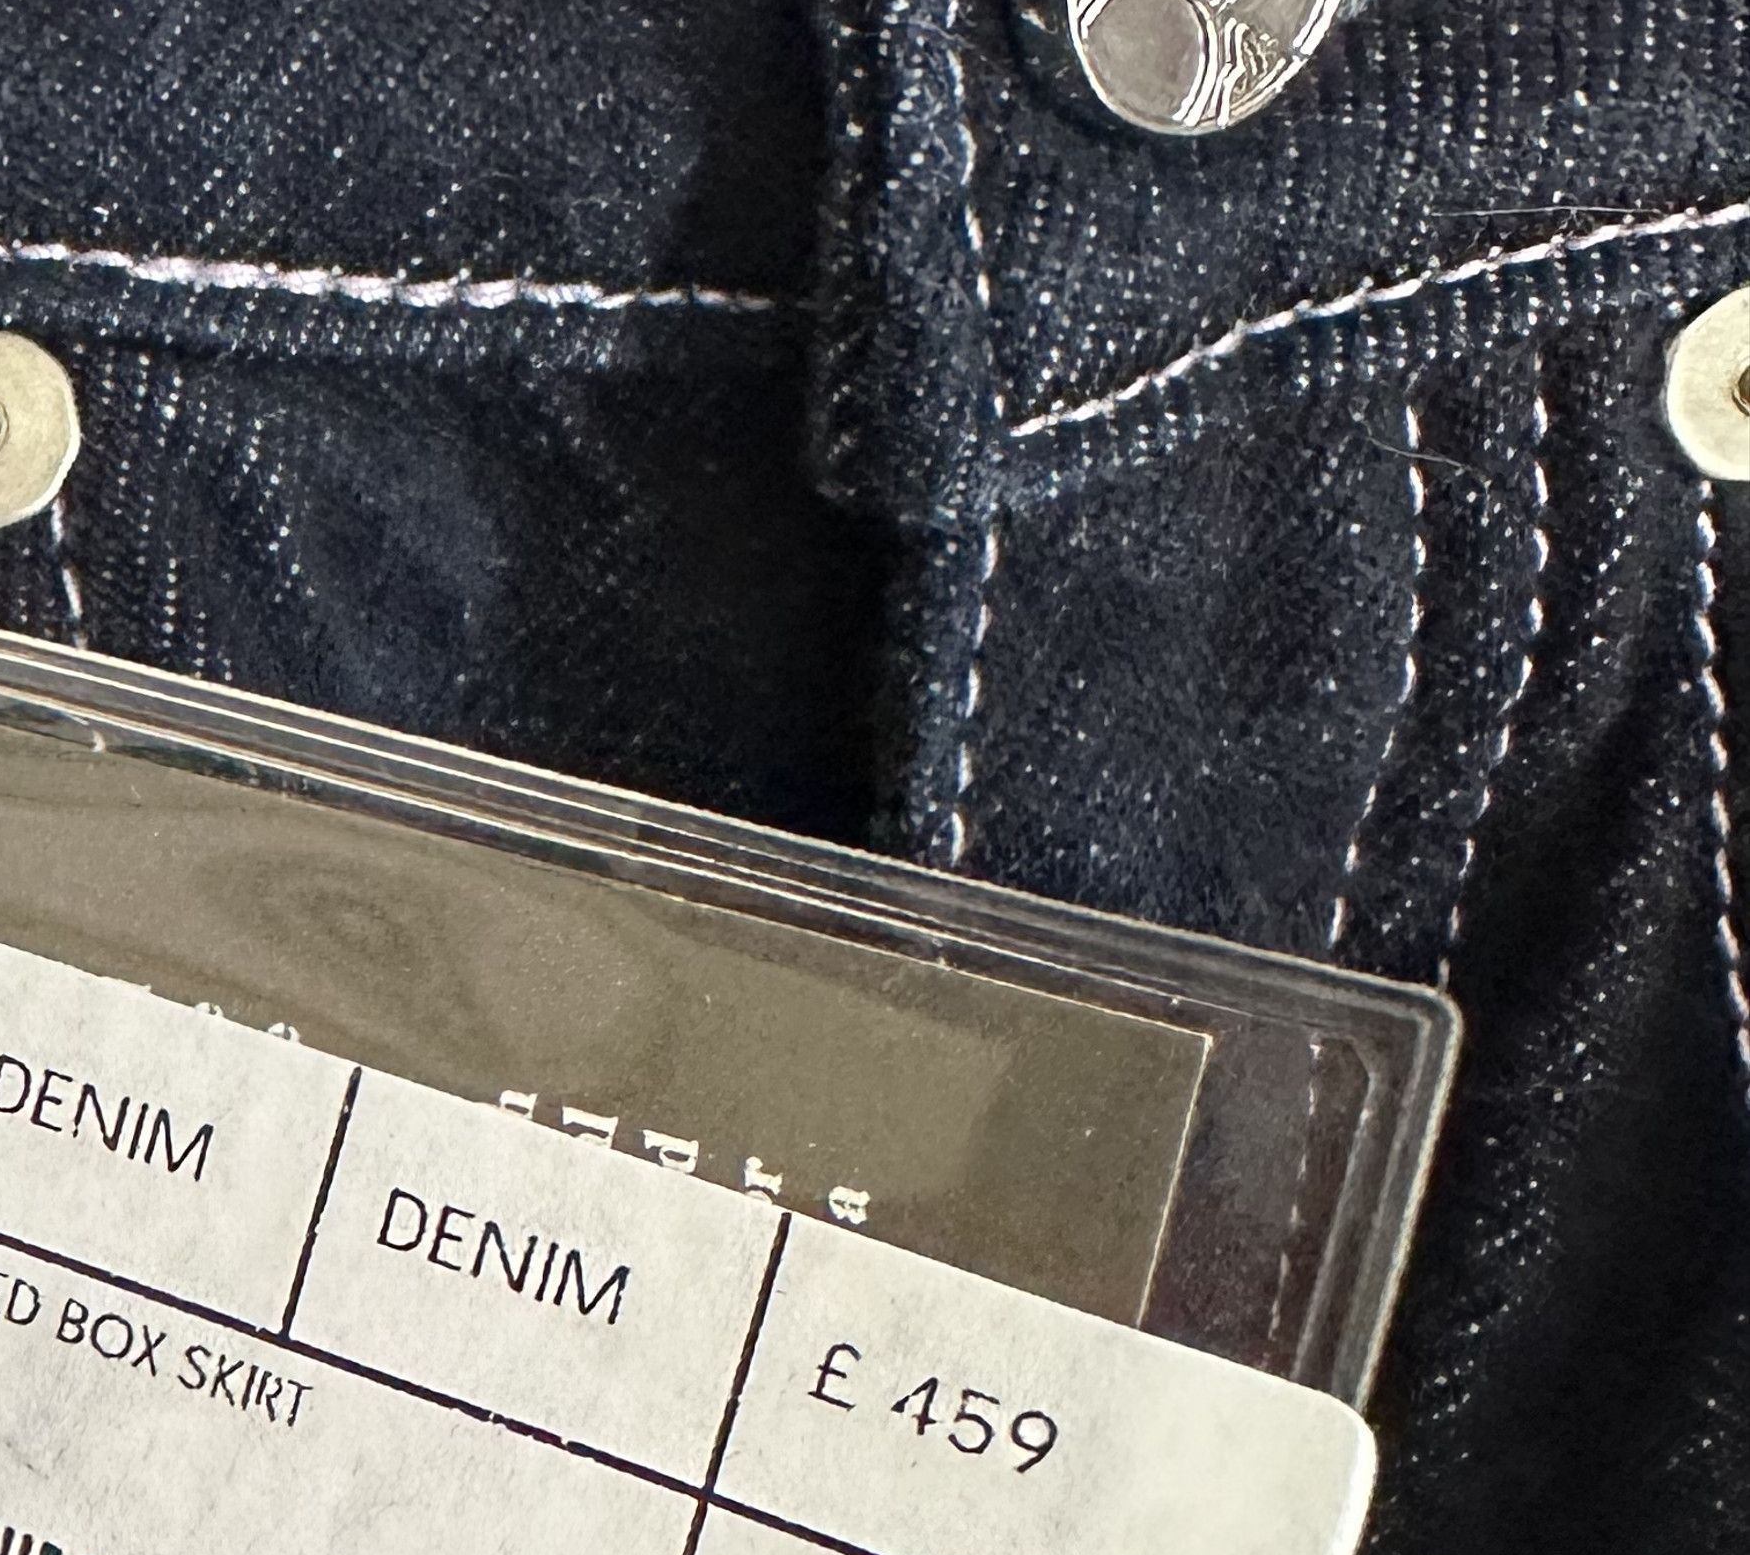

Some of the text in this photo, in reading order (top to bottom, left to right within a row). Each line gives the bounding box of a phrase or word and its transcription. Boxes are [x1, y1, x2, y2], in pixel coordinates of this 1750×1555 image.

[376, 1187, 631, 1325] DENIM
[56, 1298, 167, 1376] BOX
[178, 1343, 313, 1427] SKIRT
[807, 1342, 1059, 1473] £ 459
